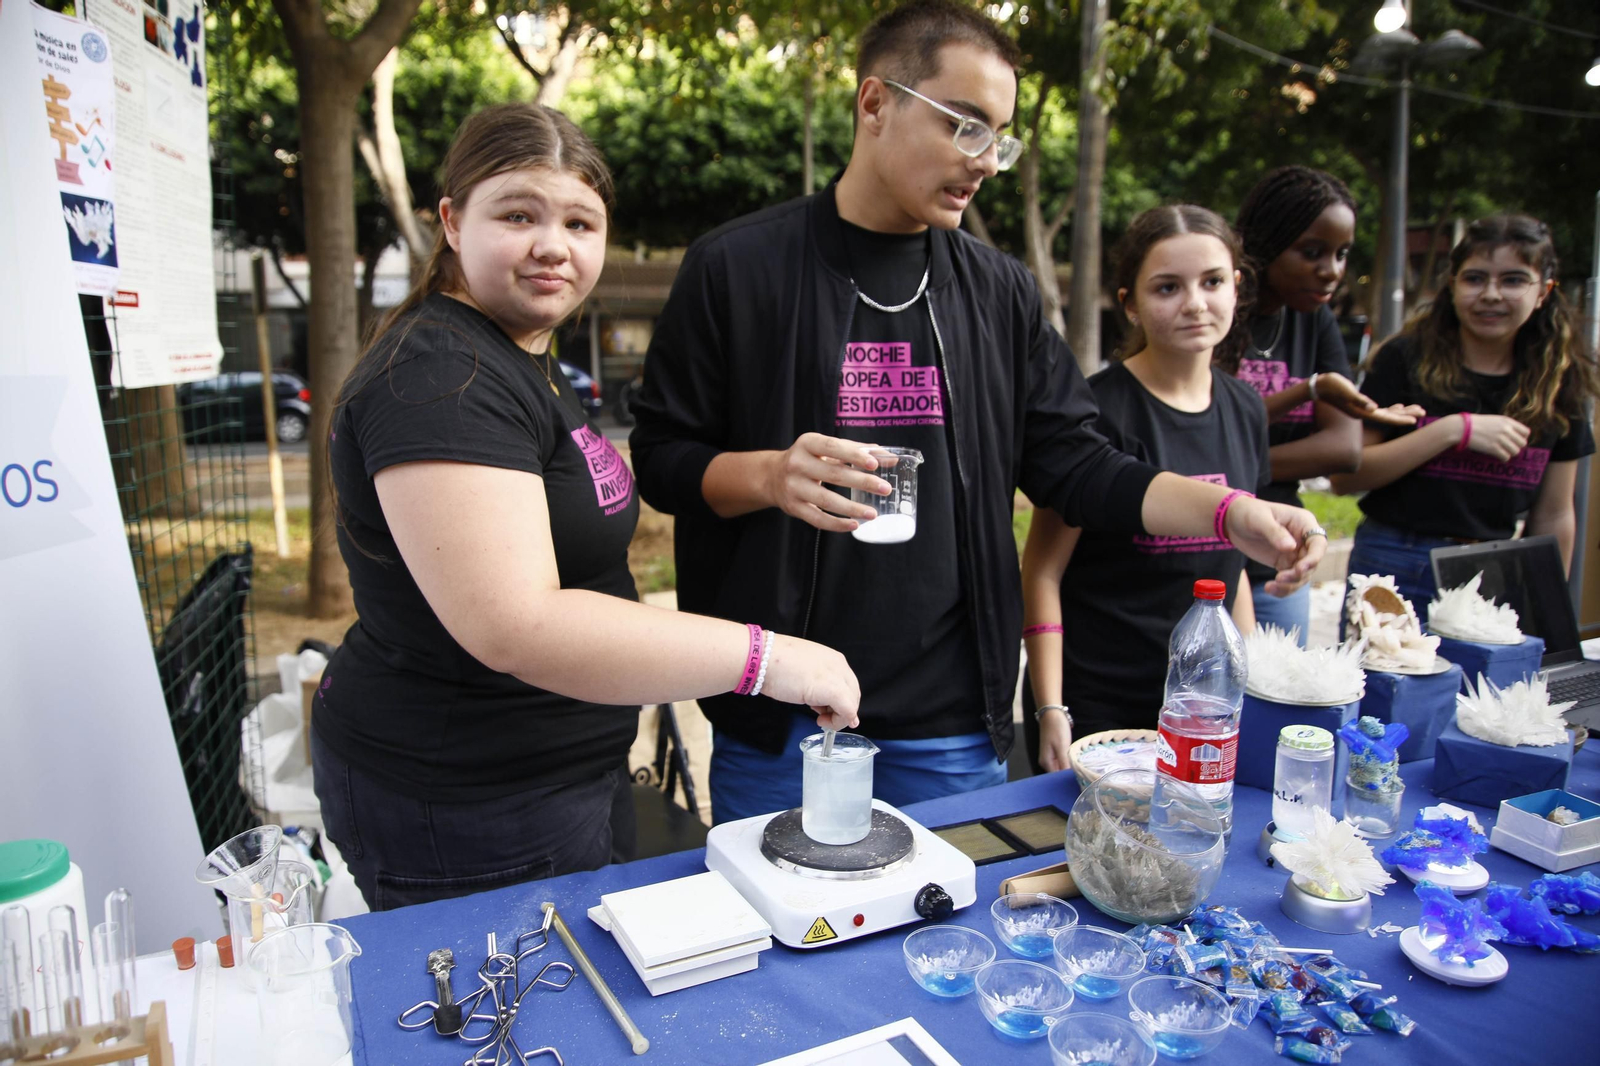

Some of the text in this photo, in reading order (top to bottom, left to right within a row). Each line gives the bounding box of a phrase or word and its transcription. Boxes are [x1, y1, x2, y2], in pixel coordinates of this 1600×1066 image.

[902, 371, 925, 387] DE
[877, 419, 893, 427] QUE
[0, 459, 58, 508] OS
[752, 644, 760, 655] DE
